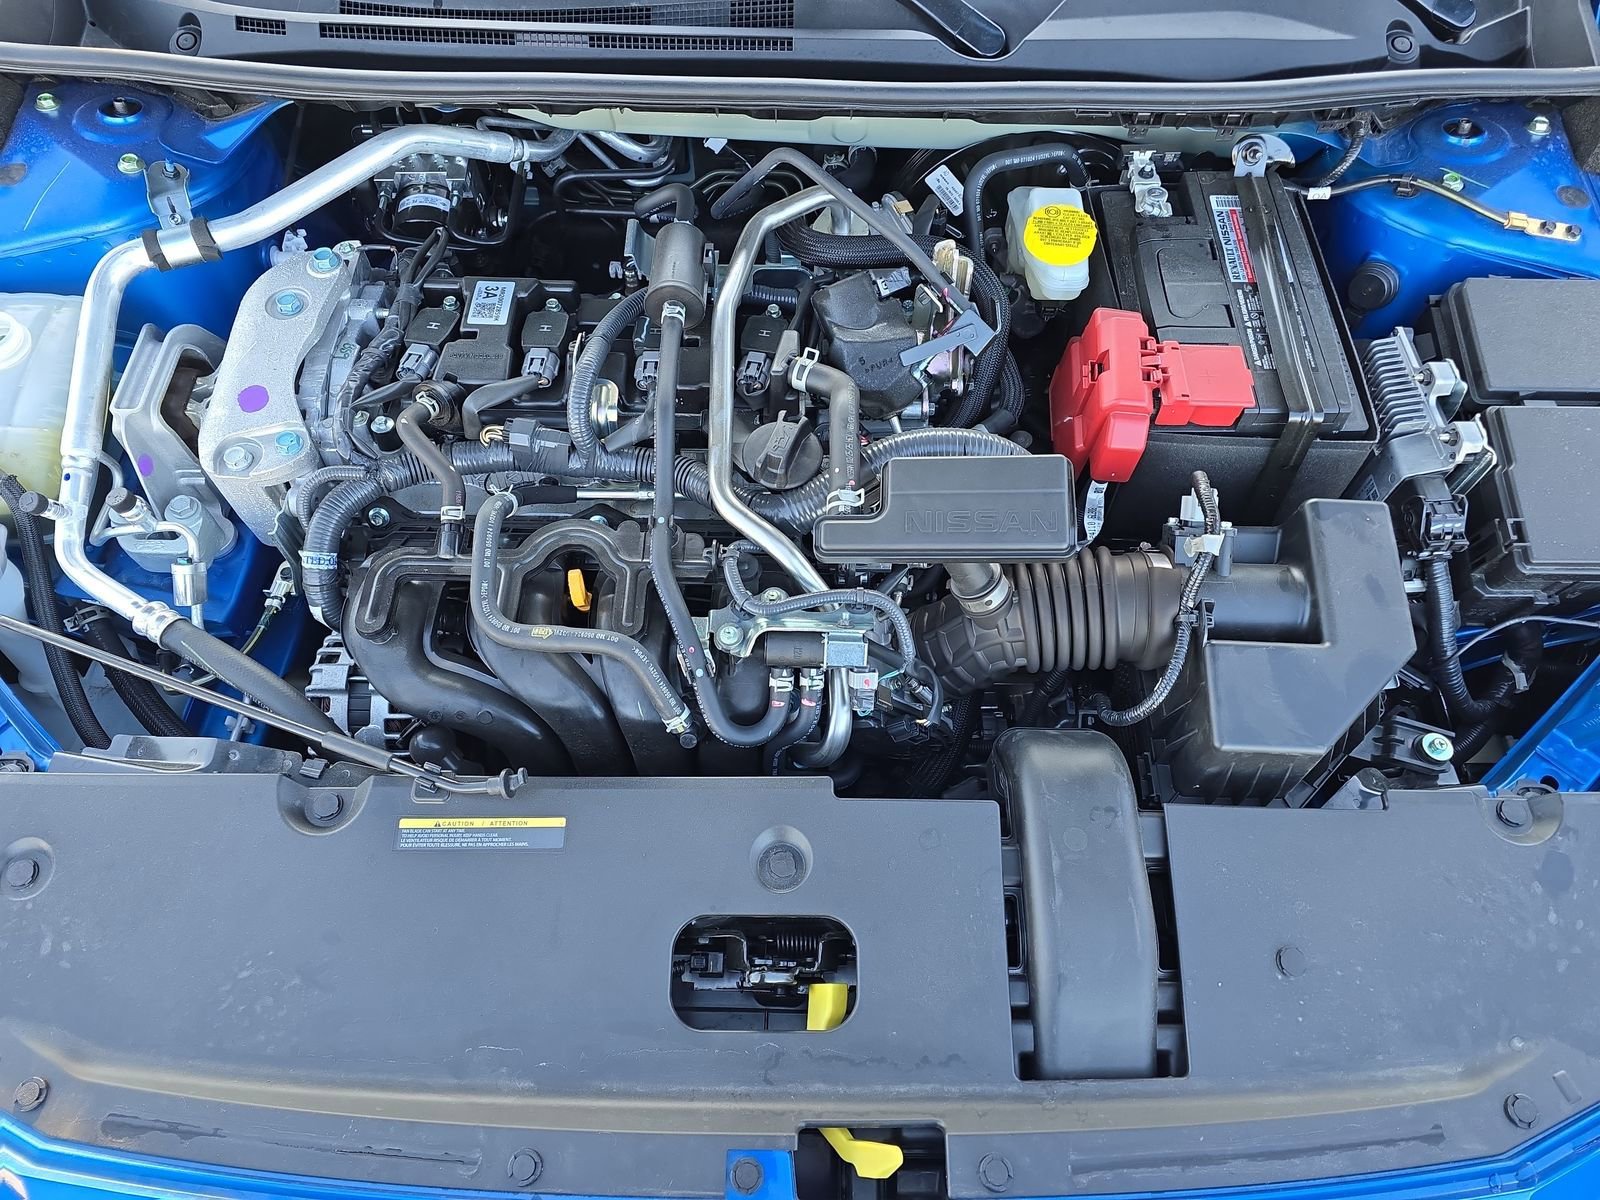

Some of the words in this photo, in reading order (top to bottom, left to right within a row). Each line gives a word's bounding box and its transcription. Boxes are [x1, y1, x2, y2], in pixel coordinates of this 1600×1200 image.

[1216, 211, 1232, 246] NISSAN
[1226, 248, 1241, 280] RENAULT
[482, 286, 499, 299] 3A
[904, 510, 1058, 533] NISSAN
